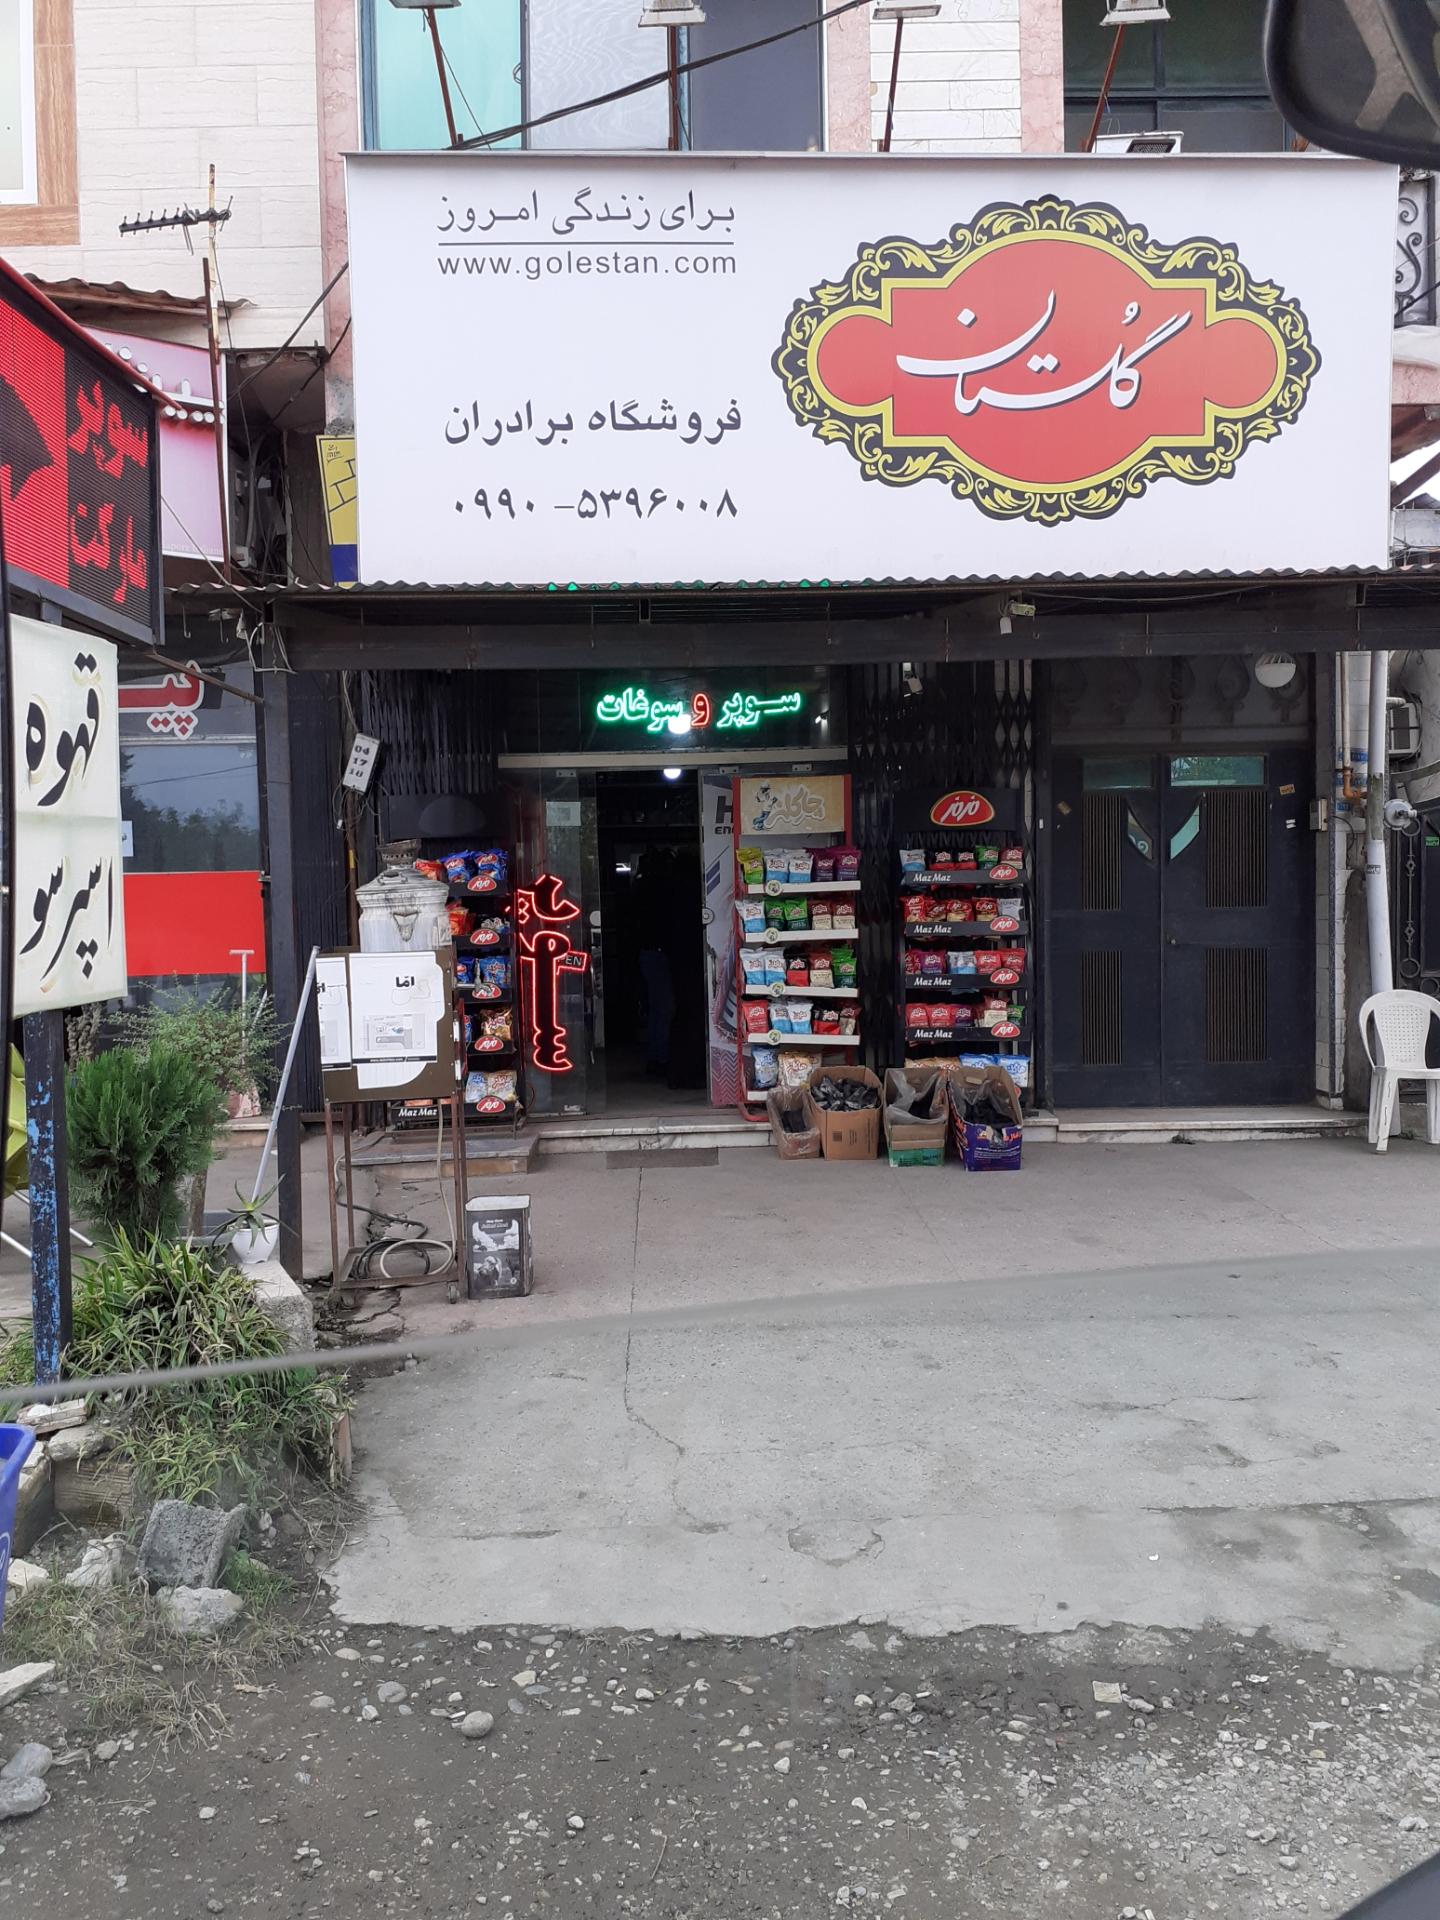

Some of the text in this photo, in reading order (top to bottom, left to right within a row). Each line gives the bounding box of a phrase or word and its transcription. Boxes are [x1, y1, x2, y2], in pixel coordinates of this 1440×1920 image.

[438, 186, 734, 235] برای زندگی امروز
[438, 250, 736, 280] www.golestan.com
[66, 380, 148, 482] سوپر
[445, 398, 742, 447] فروشگاه برادران
[456, 488, 534, 519] ۰۹۹۰
[69, 504, 147, 604] مارکت
[597, 687, 802, 732] سوپر و سوغات
[26, 652, 99, 807] قهوه
[940, 795, 981, 823] مزمز
[913, 873, 951, 882] Maz Maz
[19, 855, 113, 980] اسپرسو
[914, 925, 952, 934] Maz Maz
[914, 977, 952, 986] Maz Maz
[914, 1029, 953, 1038] Maz Maz
[398, 1107, 438, 1117] Maz Maz
